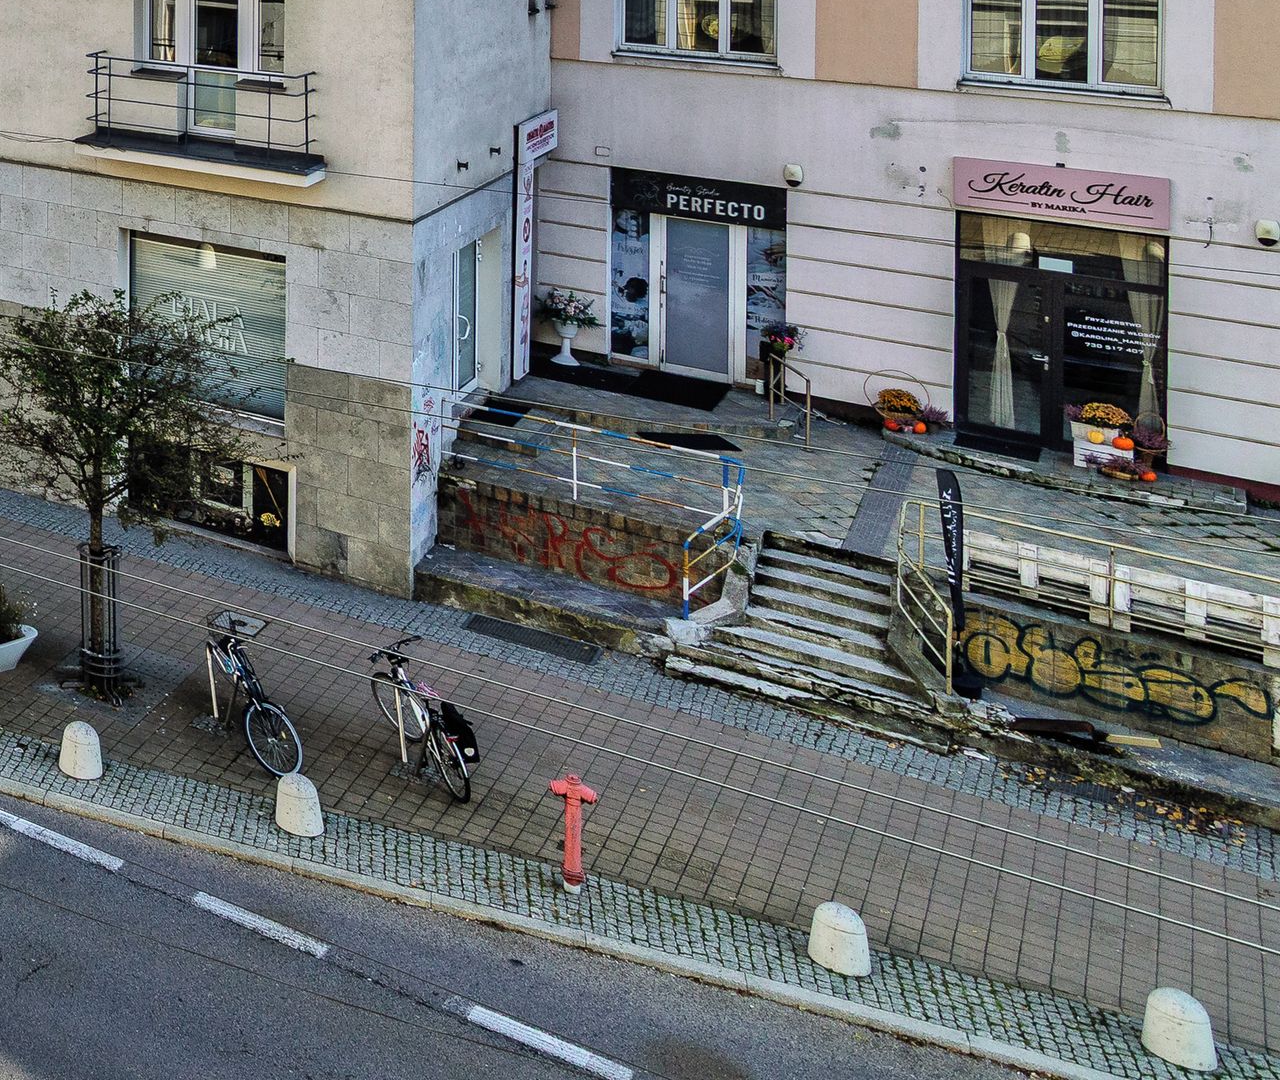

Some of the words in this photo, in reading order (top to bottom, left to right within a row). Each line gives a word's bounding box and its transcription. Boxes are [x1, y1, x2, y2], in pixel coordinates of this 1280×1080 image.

[968, 171, 1066, 197] Keratin
[1070, 183, 1154, 208] Hair
[666, 193, 765, 221] PERFECTO
[1031, 201, 1043, 209] BY
[1044, 202, 1087, 214] MARIKA
[1084, 315, 1142, 328] FRYZJERSTWO
[1084, 341, 1103, 349] 730
[1105, 344, 1123, 352] 517
